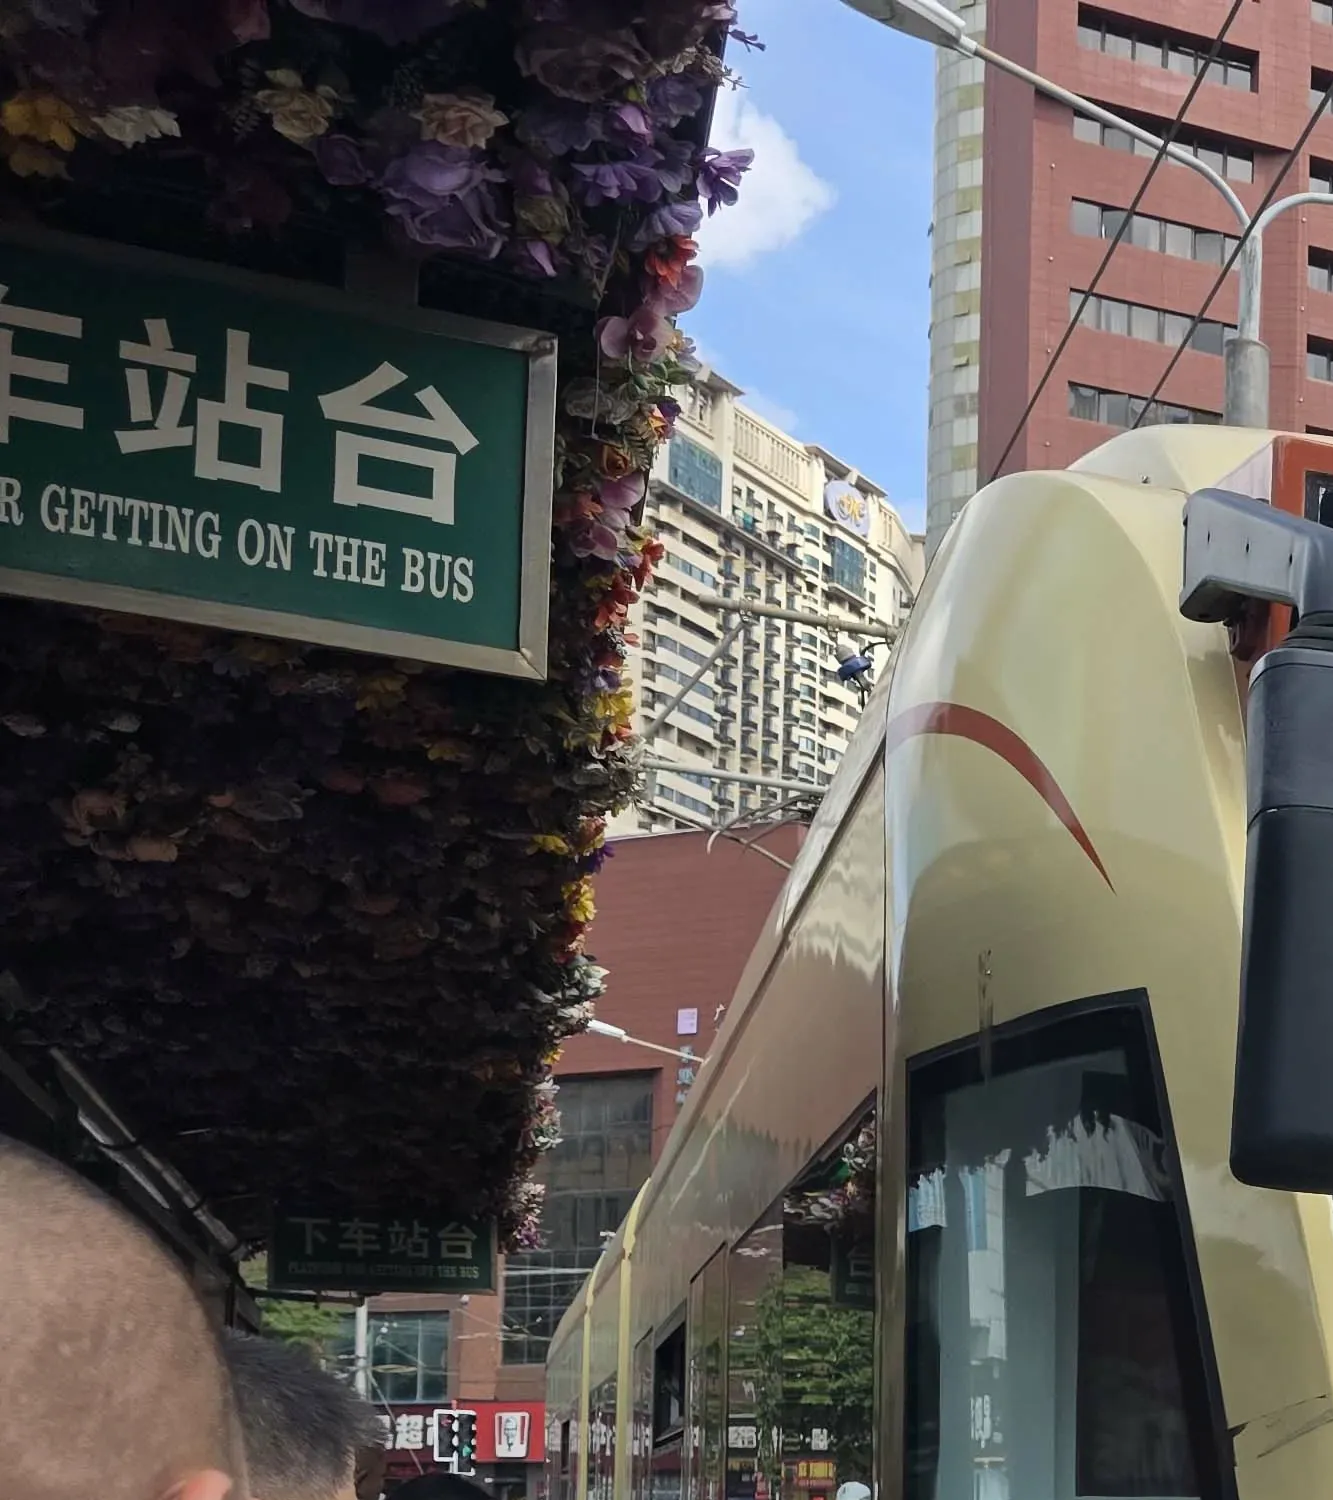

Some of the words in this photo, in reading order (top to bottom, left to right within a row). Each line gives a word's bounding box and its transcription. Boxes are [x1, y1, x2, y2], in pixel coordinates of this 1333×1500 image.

[40, 483, 222, 560] GETTING
[237, 518, 295, 572] ON
[309, 530, 387, 587] THE
[401, 547, 475, 603] BUS
[286, 1217, 477, 1259] 下车站台
